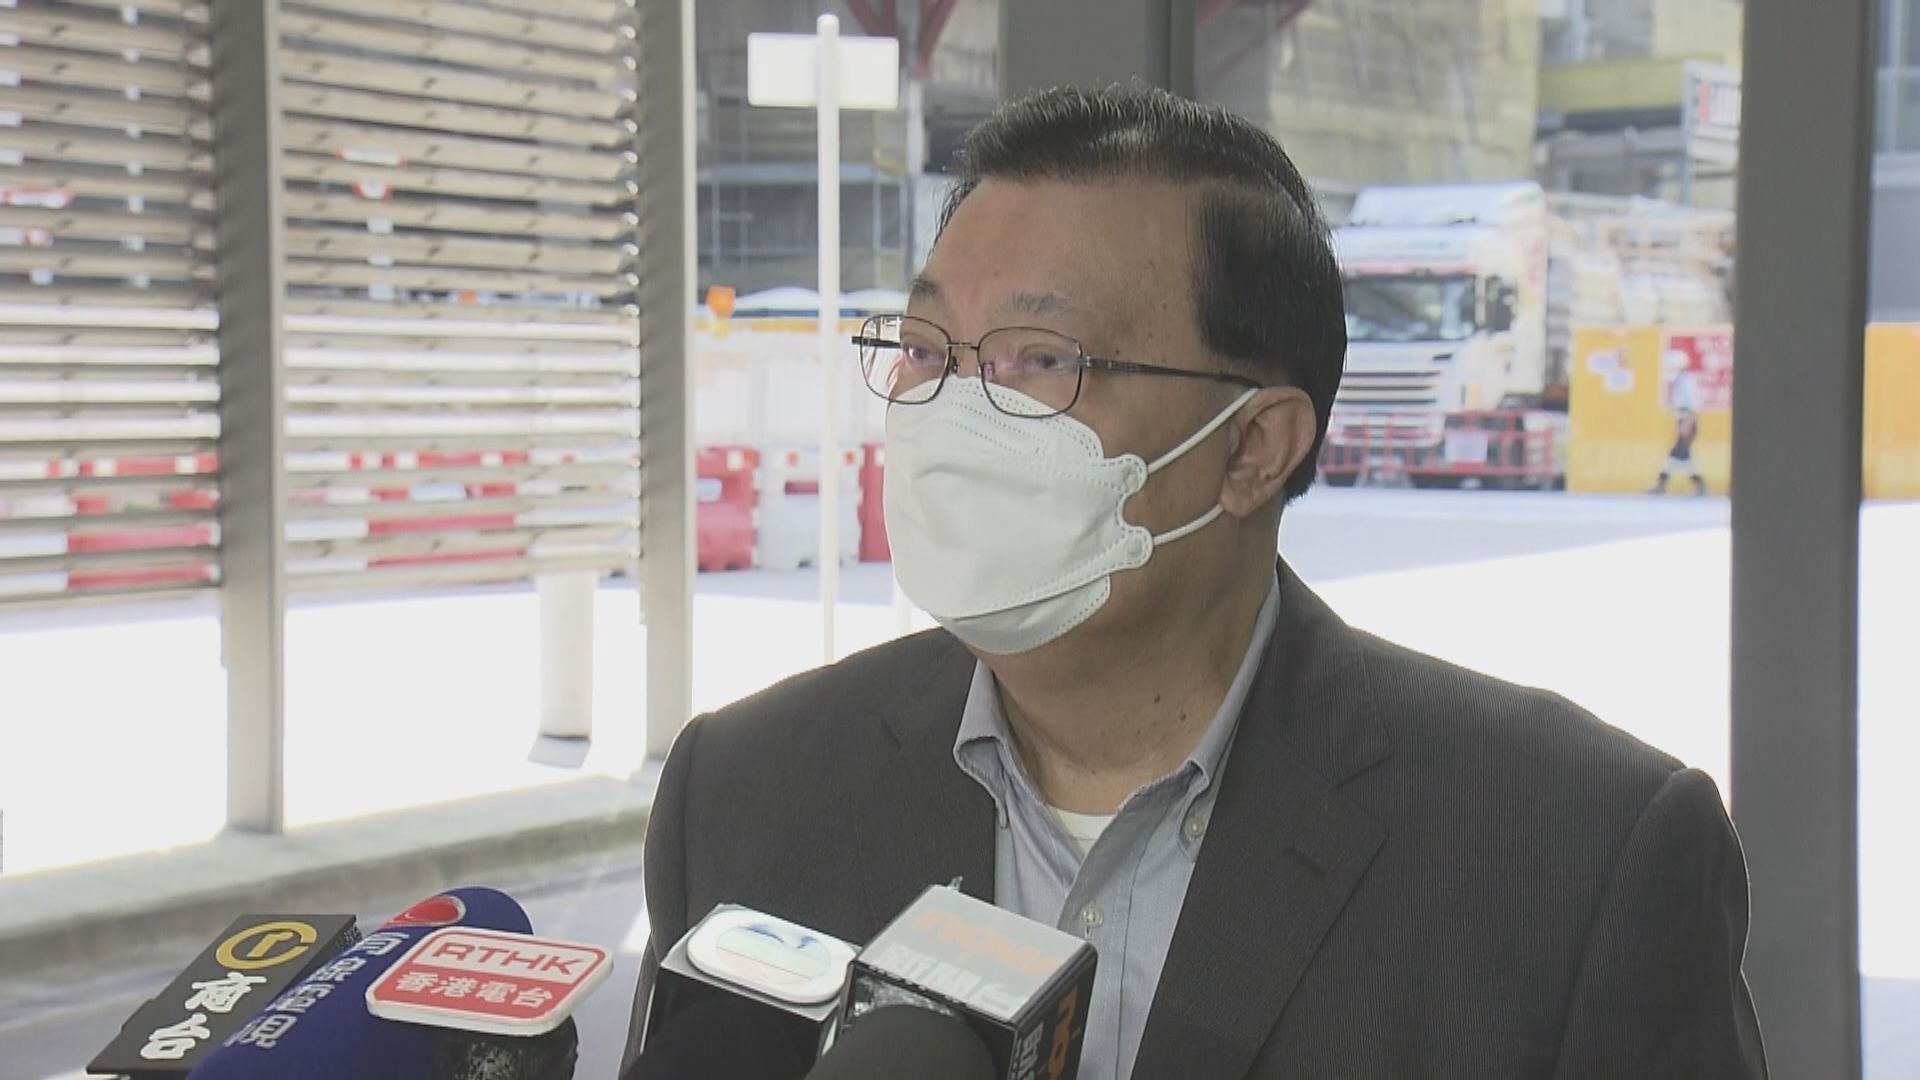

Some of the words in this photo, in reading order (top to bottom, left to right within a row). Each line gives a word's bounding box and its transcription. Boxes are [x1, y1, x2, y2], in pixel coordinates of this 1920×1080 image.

[431, 941, 584, 976] RTHK
[395, 971, 553, 1008] 香港電台
[139, 970, 268, 1060] 商台
